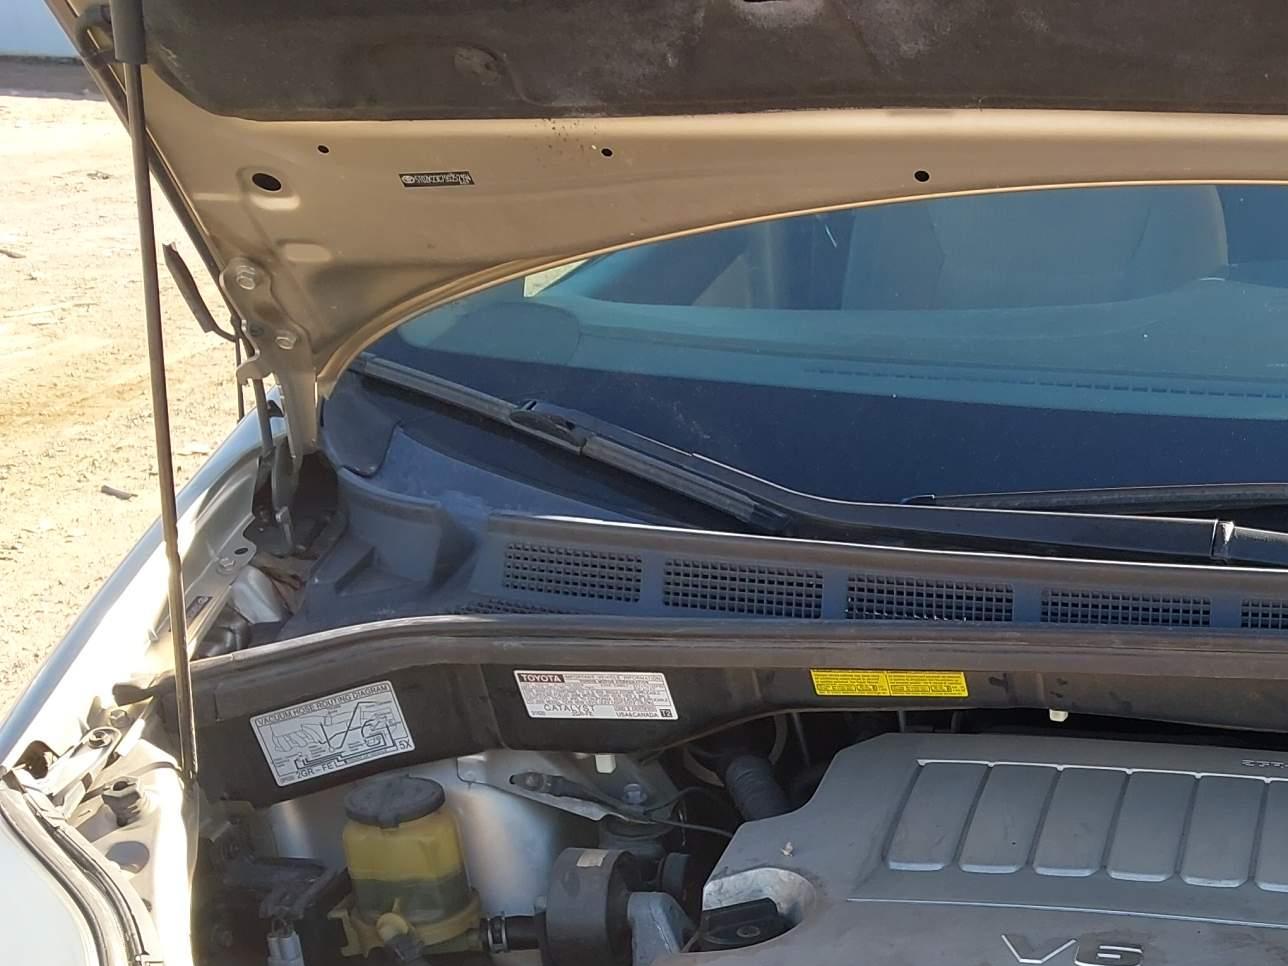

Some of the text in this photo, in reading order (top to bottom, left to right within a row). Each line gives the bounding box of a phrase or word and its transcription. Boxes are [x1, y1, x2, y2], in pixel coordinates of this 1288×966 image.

[520, 674, 561, 682] TOYOTA
[256, 711, 292, 726] VACUUM
[293, 703, 317, 717] HOSE
[317, 694, 351, 710] ROUTING
[351, 684, 388, 700] DIAGRAM
[543, 703, 595, 712] CATALYST
[661, 709, 672, 717] T2
[399, 740, 413, 750] 5X
